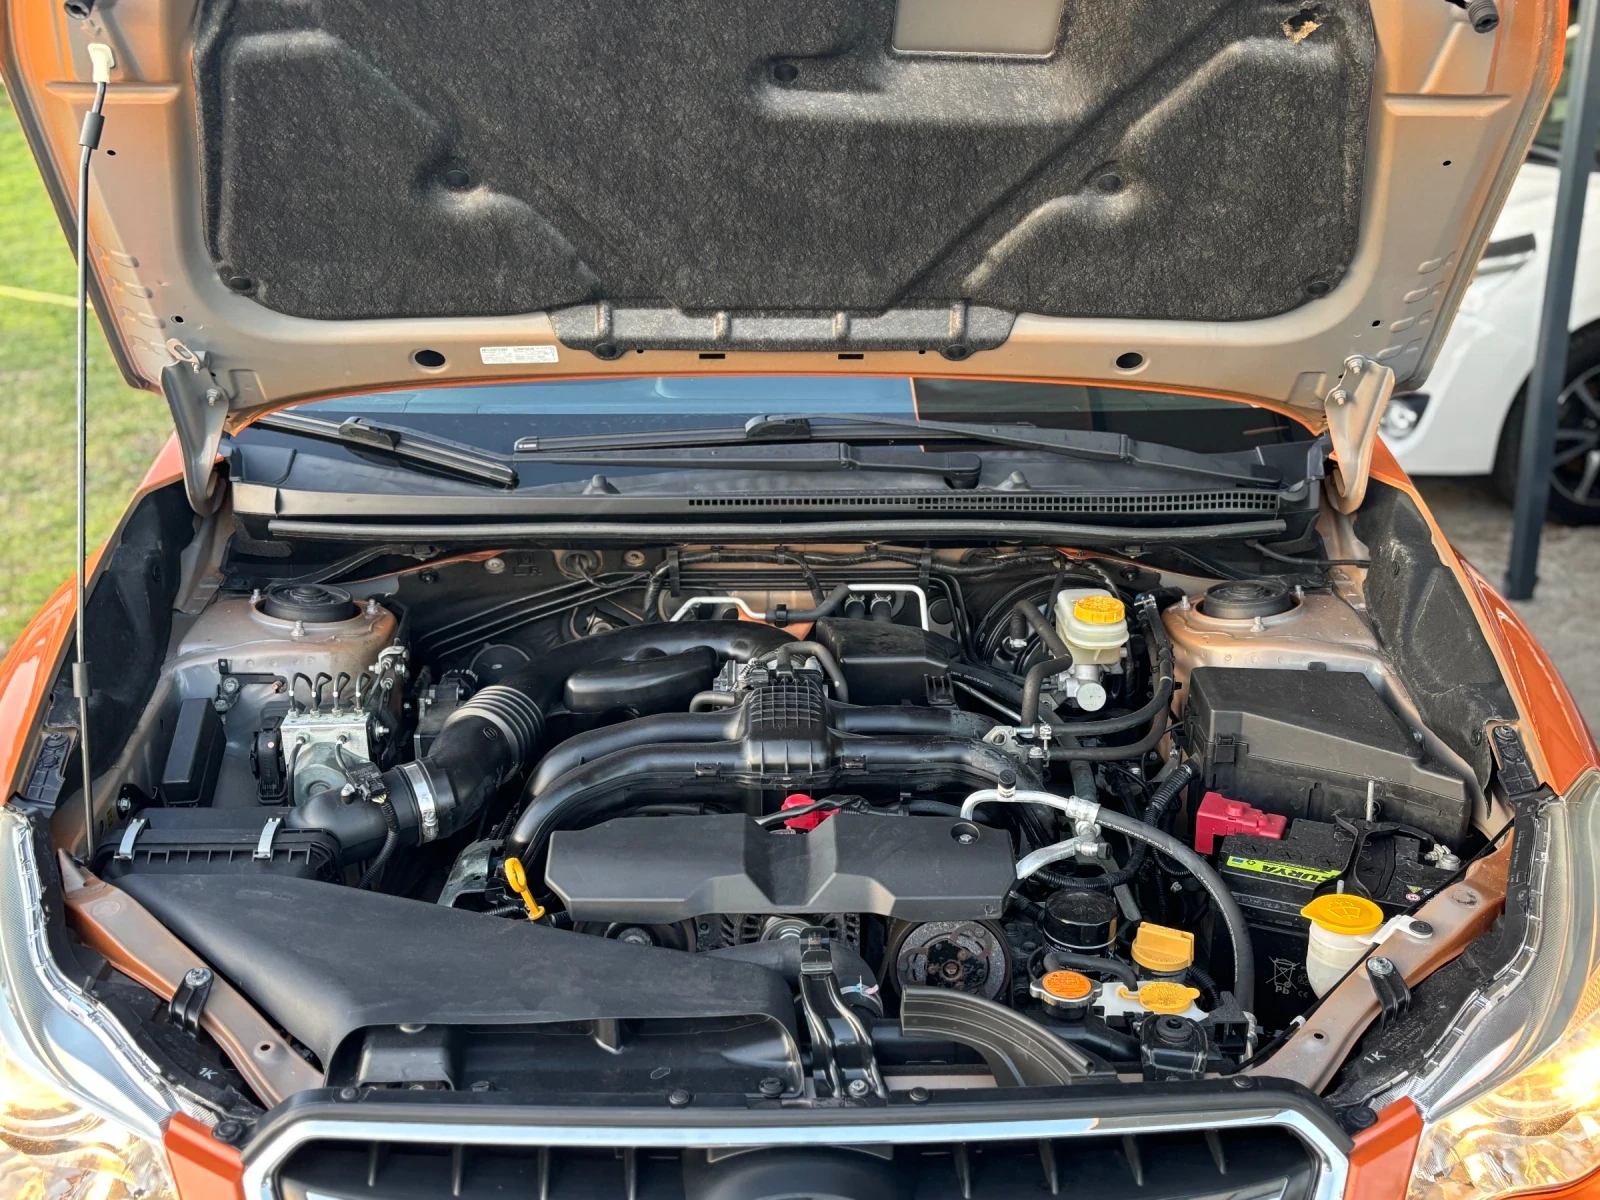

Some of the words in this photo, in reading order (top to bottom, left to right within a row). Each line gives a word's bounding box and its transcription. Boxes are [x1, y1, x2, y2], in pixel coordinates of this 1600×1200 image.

[1274, 985, 1290, 995] Pb
[1363, 1050, 1387, 1064] 1K
[198, 1067, 219, 1080] 1K
